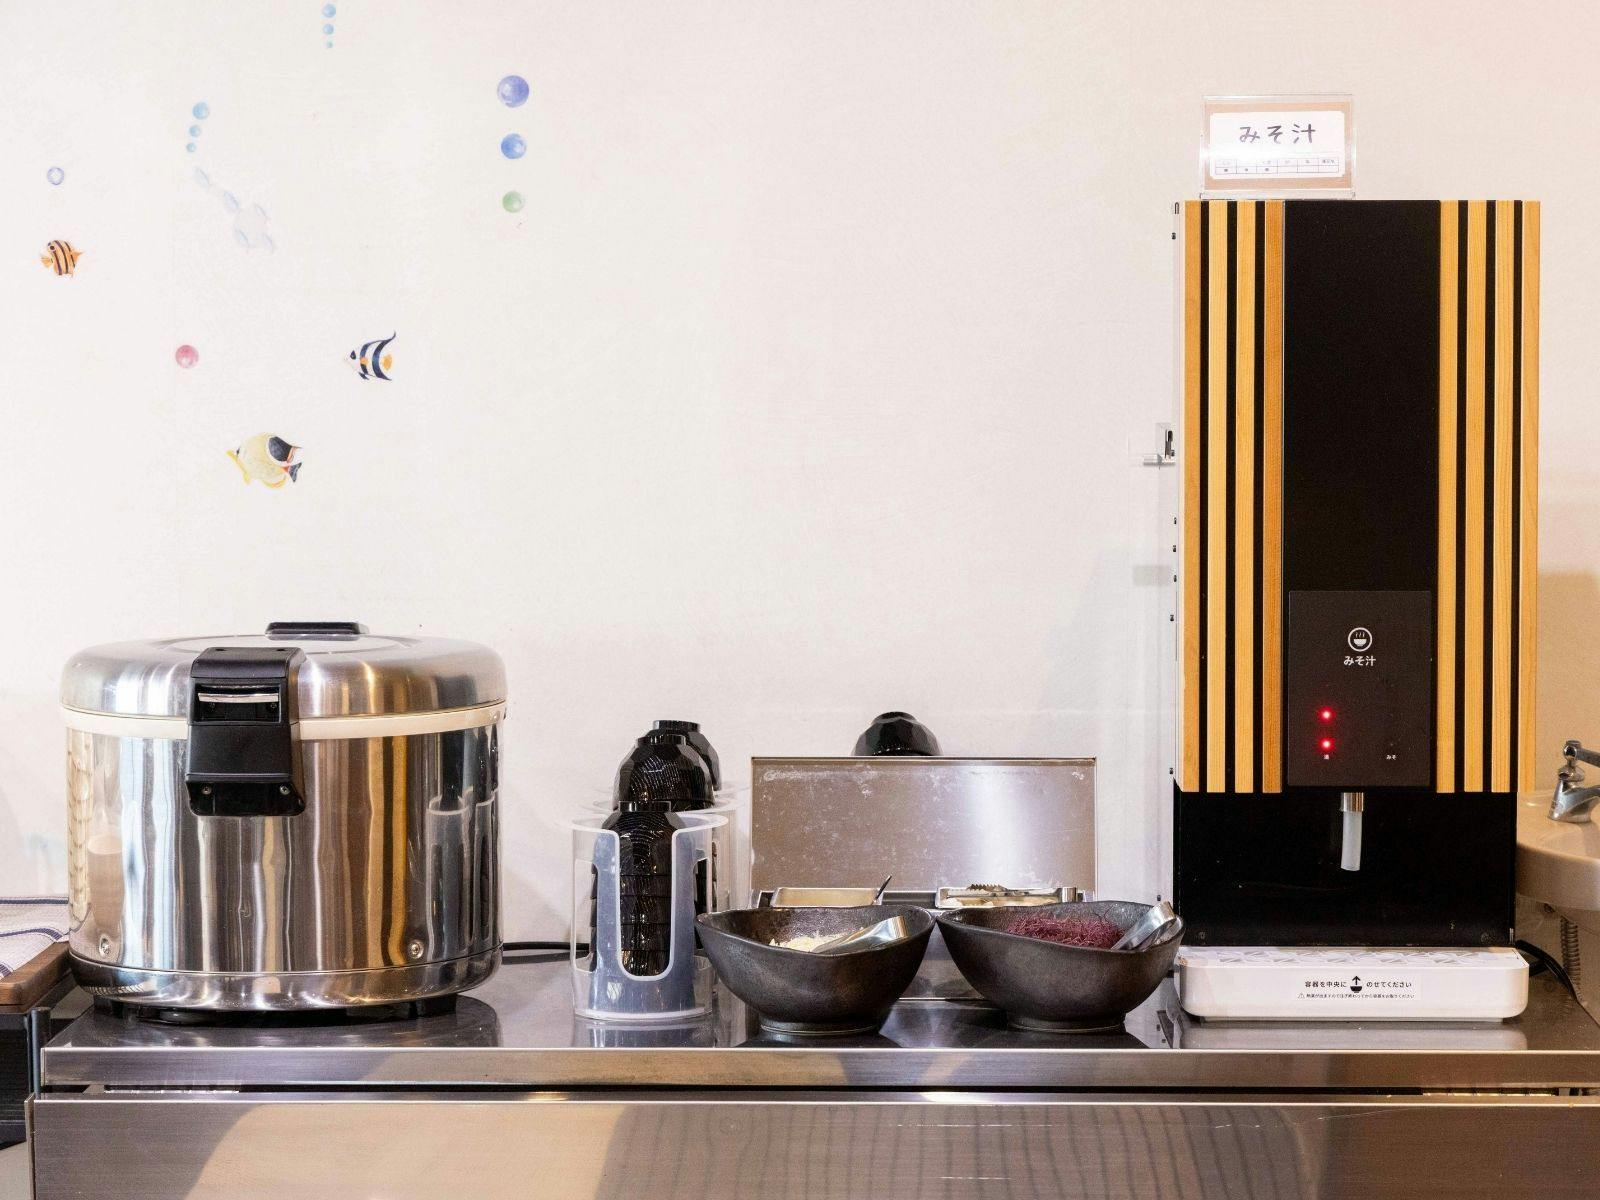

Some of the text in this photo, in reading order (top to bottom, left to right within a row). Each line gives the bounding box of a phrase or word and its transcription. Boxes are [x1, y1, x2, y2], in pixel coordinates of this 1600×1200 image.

[1239, 123, 1316, 143] みそ汁
[1343, 655, 1376, 666] みそ汁
